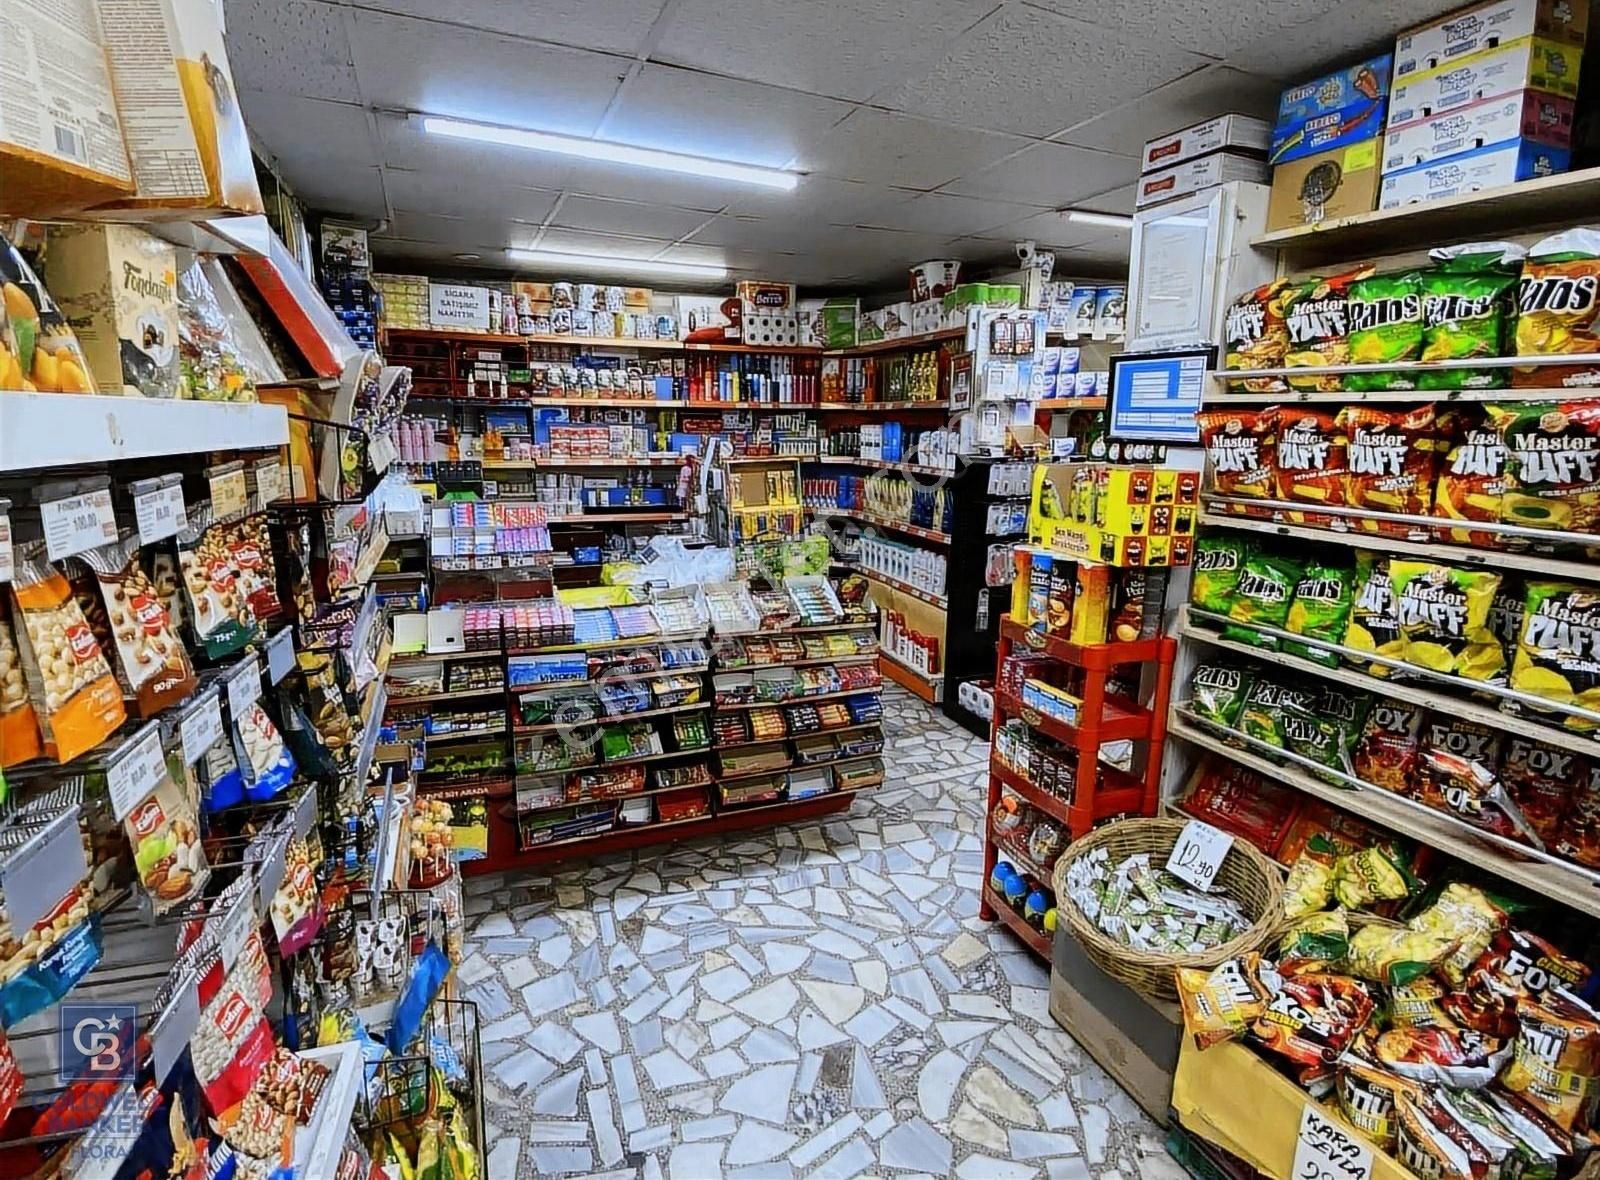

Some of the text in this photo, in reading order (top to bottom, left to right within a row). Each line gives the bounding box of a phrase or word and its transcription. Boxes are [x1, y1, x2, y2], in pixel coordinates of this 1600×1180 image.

[1293, 300, 1348, 315] Master
[1287, 311, 1348, 344] PUFF
[1212, 435, 1258, 448] Master
[1279, 442, 1330, 470] PUFF
[1515, 433, 1597, 451] Master
[1210, 448, 1258, 472] PUFF
[1350, 445, 1408, 476] PUFF
[1404, 582, 1467, 606] Master
[1400, 597, 1468, 636] PUFF
[1375, 708, 1411, 734] OX
[1431, 724, 1489, 758] FOX
[1511, 739, 1573, 780] FOX
[1307, 1113, 1361, 1158] KARA
[1299, 1132, 1366, 1180] SEVDA
